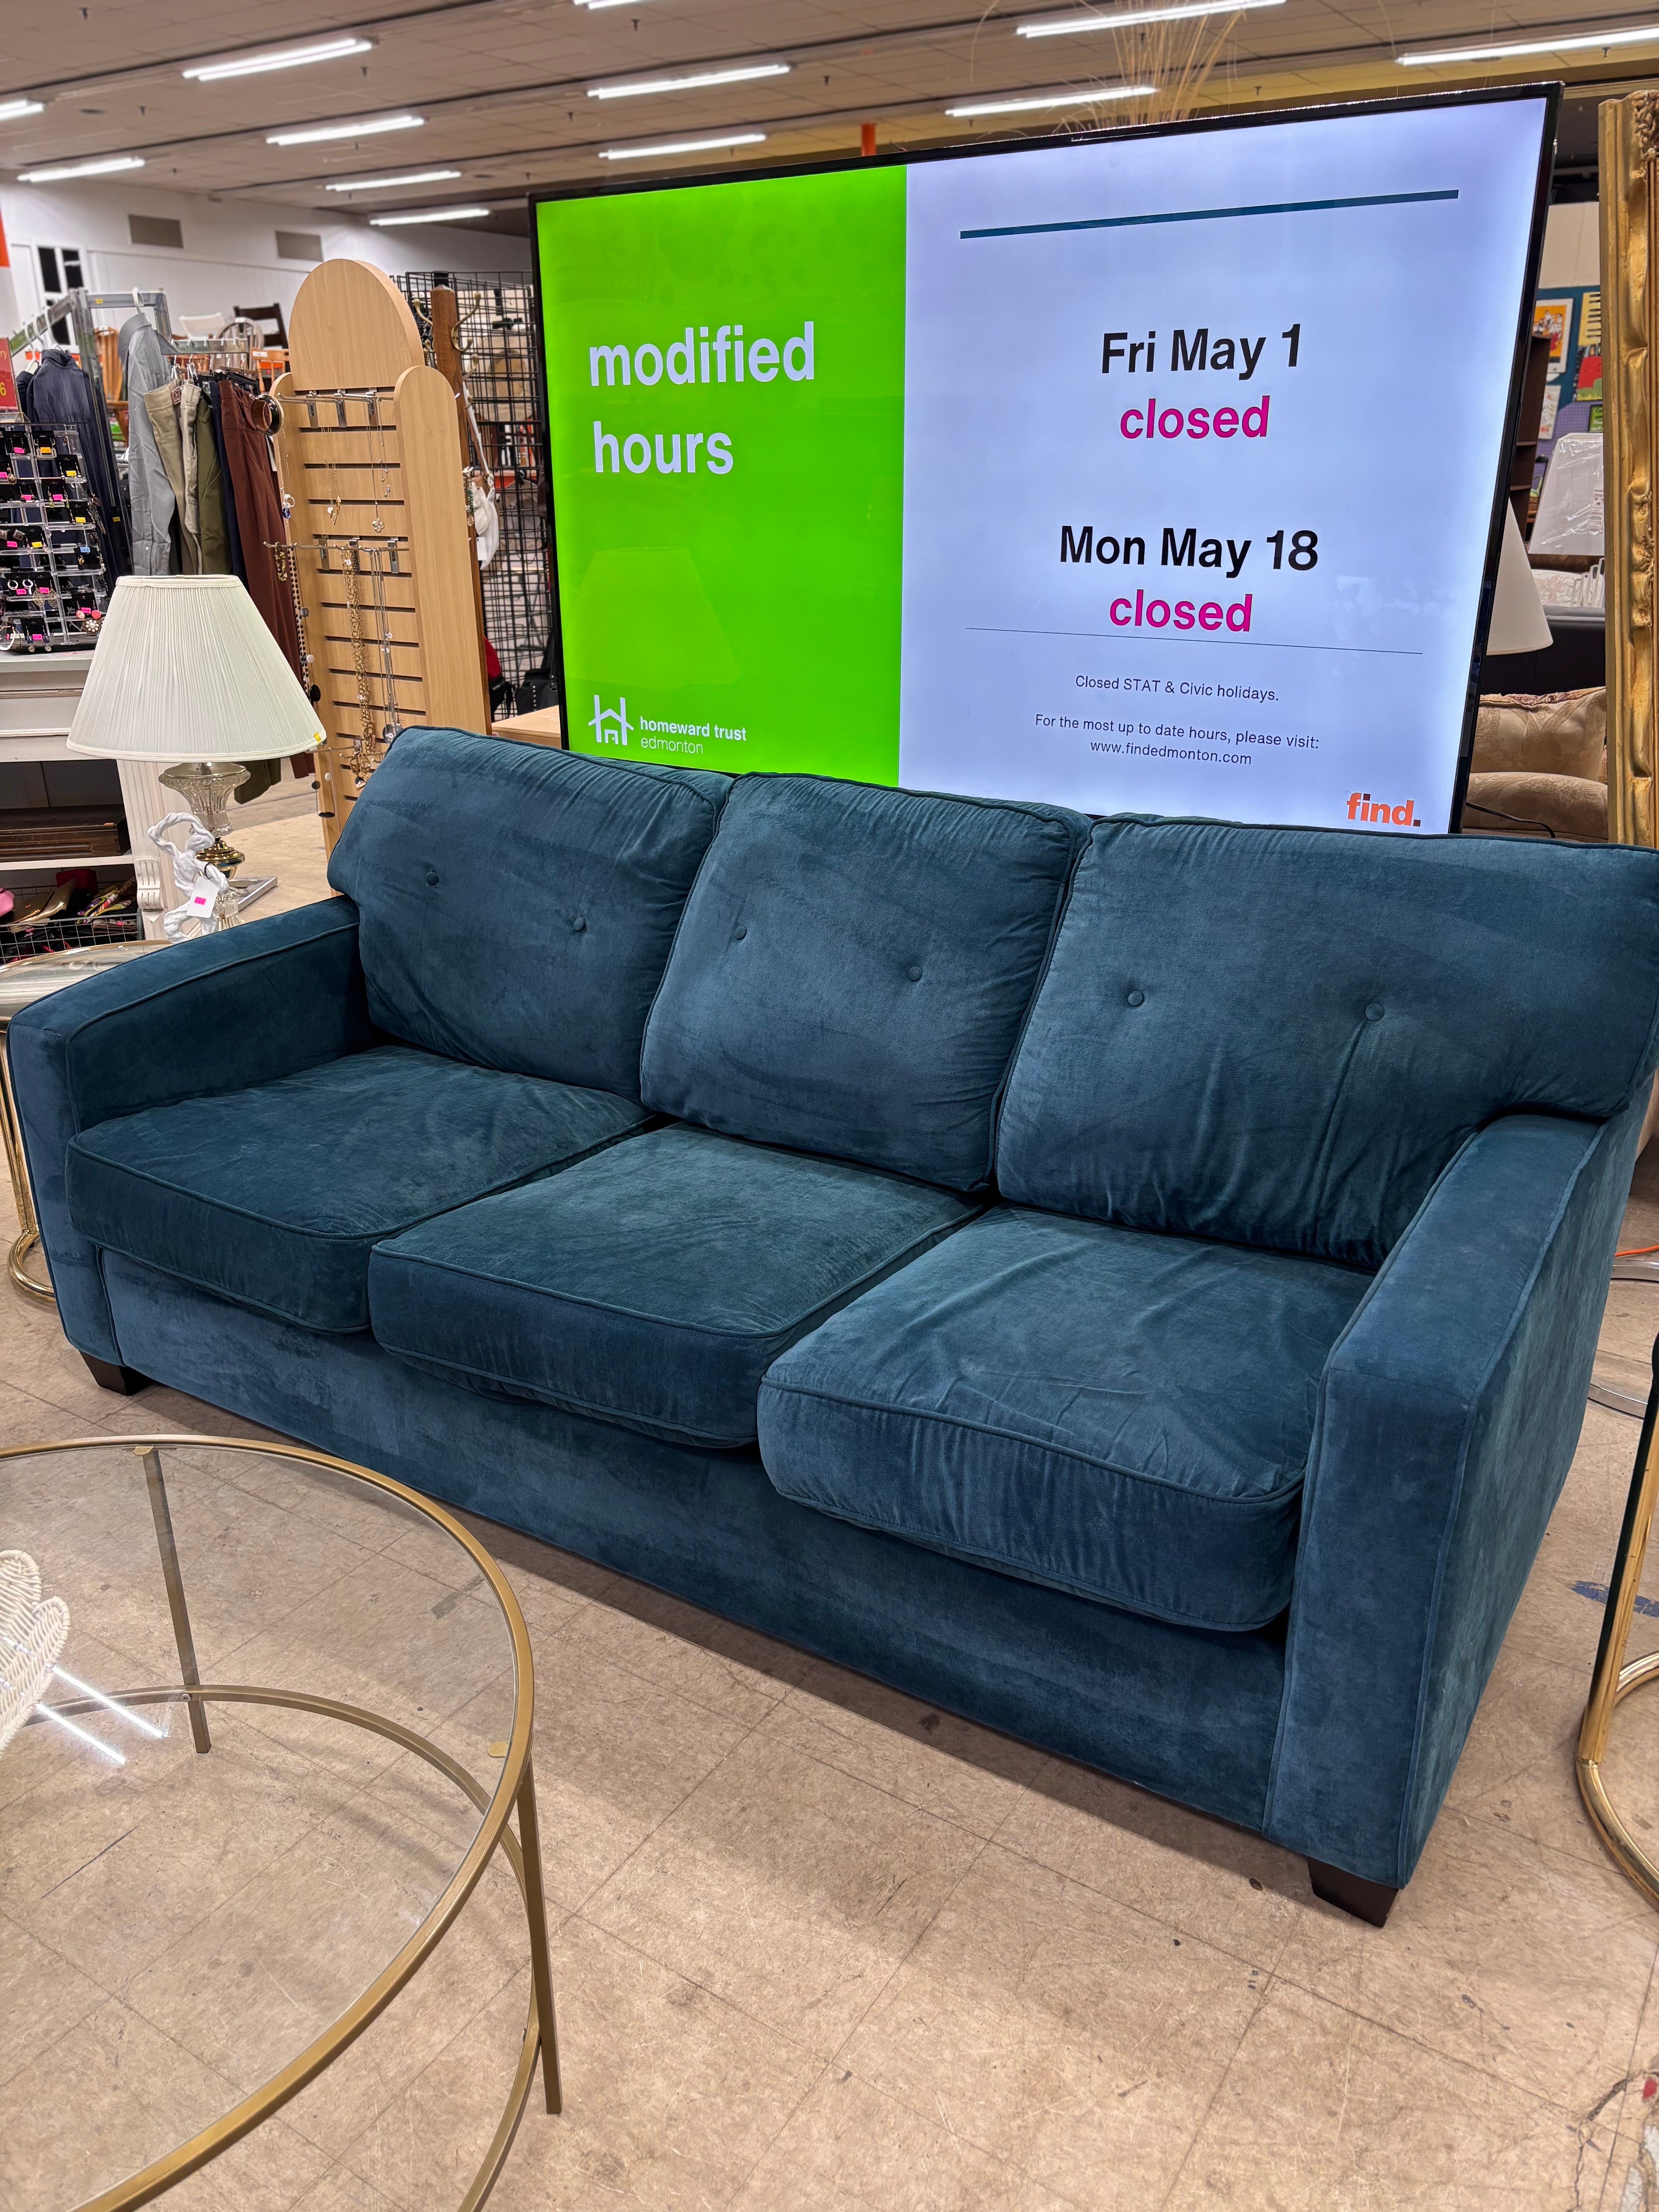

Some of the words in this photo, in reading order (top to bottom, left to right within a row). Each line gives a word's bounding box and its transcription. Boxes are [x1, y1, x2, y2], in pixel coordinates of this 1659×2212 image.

[589, 321, 814, 386] modified
[1101, 331, 1156, 374] Fri
[1170, 328, 1266, 381] May
[1281, 323, 1300, 367] 1
[1120, 395, 1271, 440] closed
[593, 420, 733, 474] hours
[1060, 525, 1146, 565] Mon
[1161, 527, 1252, 579] May
[1266, 529, 1318, 571] 18
[1109, 589, 1253, 632] closed
[1075, 675, 1119, 690] Closed
[1123, 678, 1161, 692] STAT
[1165, 681, 1175, 694] &
[1180, 682, 1213, 696] Civic
[1217, 684, 1279, 703] holidays.
[640, 716, 710, 737] homeward
[714, 724, 747, 741] trust
[641, 736, 704, 754] edmonton
[1035, 714, 1056, 726] For
[1060, 716, 1079, 728] the
[1083, 720, 1115, 732] most
[1118, 723, 1134, 736] up
[1139, 723, 1151, 734] to
[1155, 724, 1185, 737] date
[1189, 726, 1231, 744] hours,
[1235, 730, 1282, 745] please
[1286, 734, 1319, 749] visit:
[1090, 742, 1252, 765] www.findedmonton.com
[1346, 792, 1421, 827] find.
